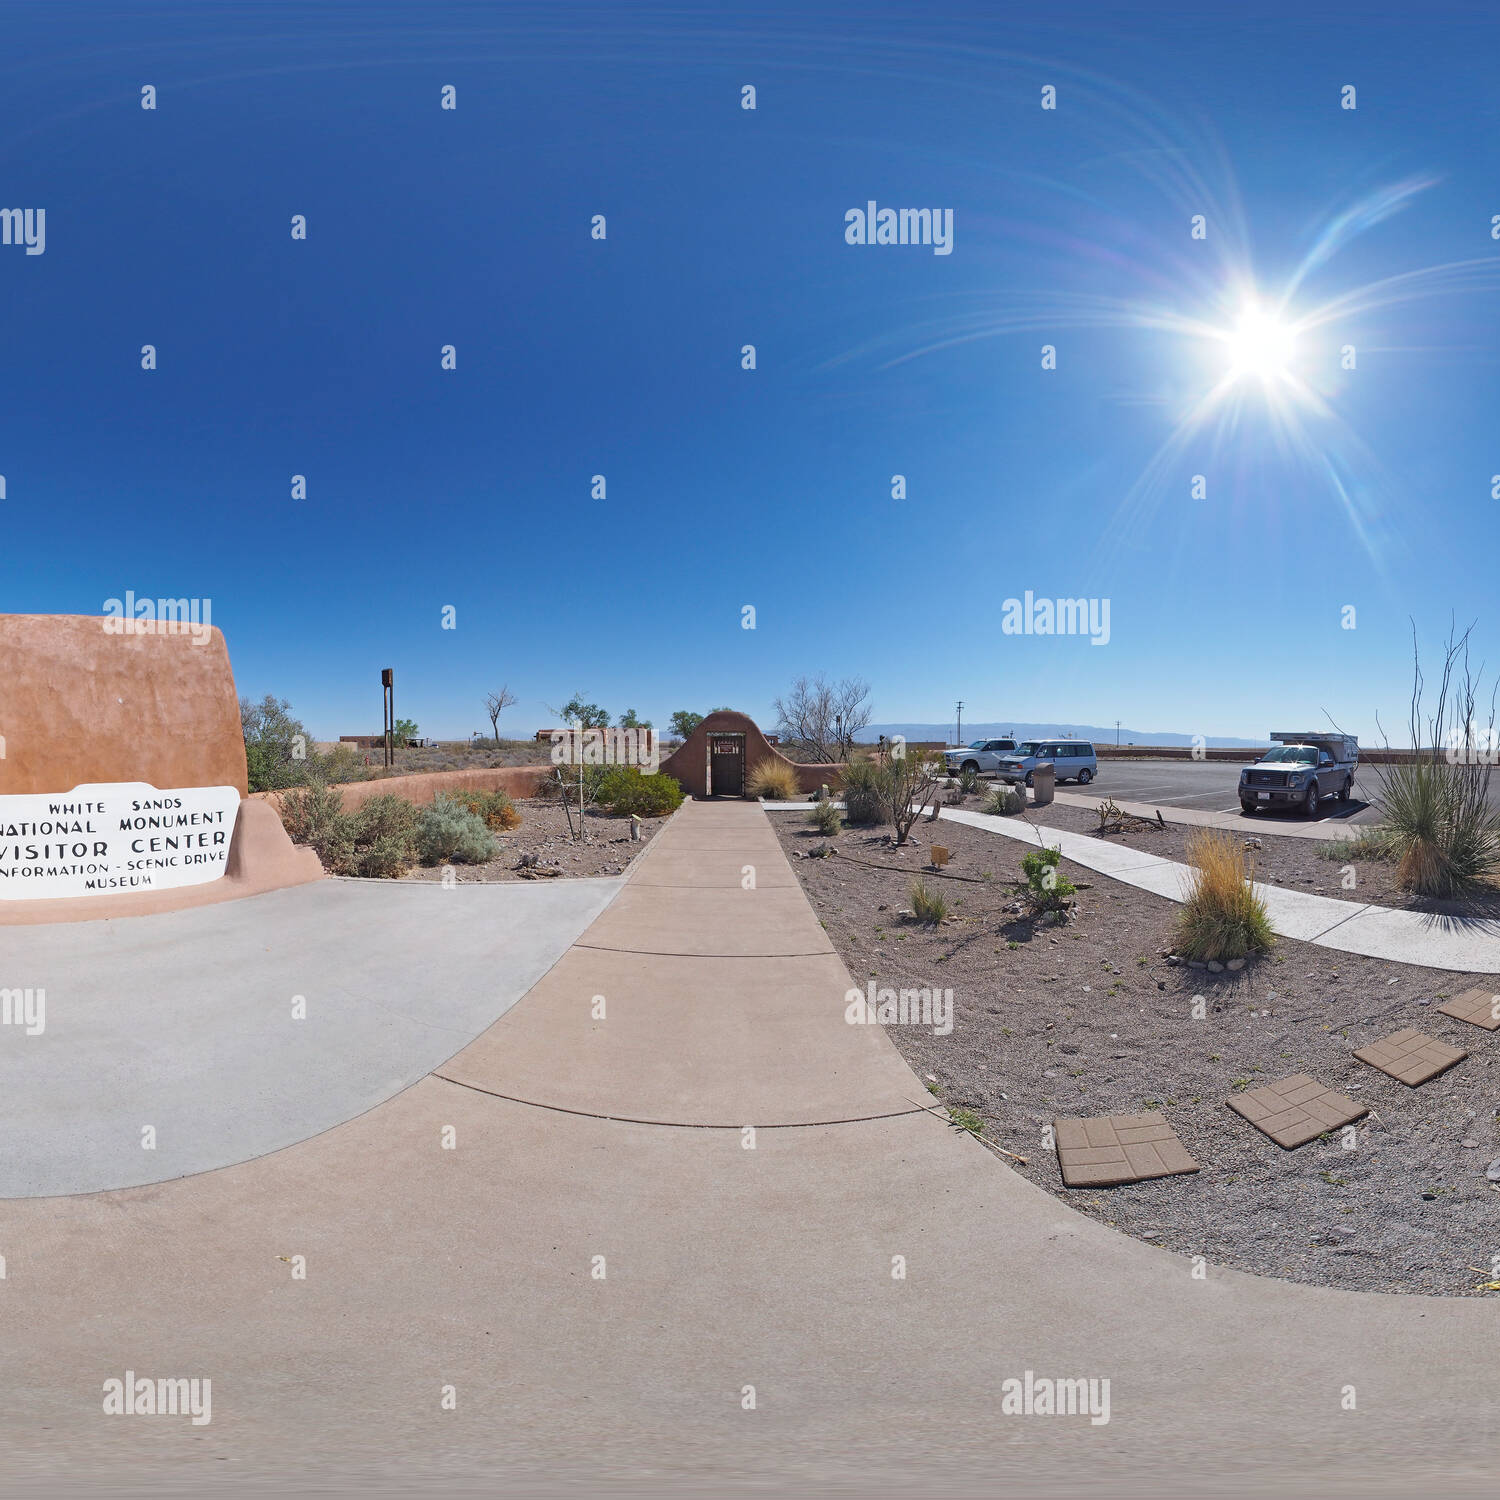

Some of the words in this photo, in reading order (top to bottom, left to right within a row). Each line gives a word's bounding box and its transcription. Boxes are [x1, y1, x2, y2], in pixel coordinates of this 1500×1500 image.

[49, 803, 105, 814] WHITE
[132, 799, 182, 811] SANDS
[120, 811, 224, 831] MONUMENT
[131, 831, 225, 853] CENTER
[128, 857, 178, 870] SCENIC
[184, 851, 225, 865] DRIVE
[85, 876, 152, 889] MUSEUM
